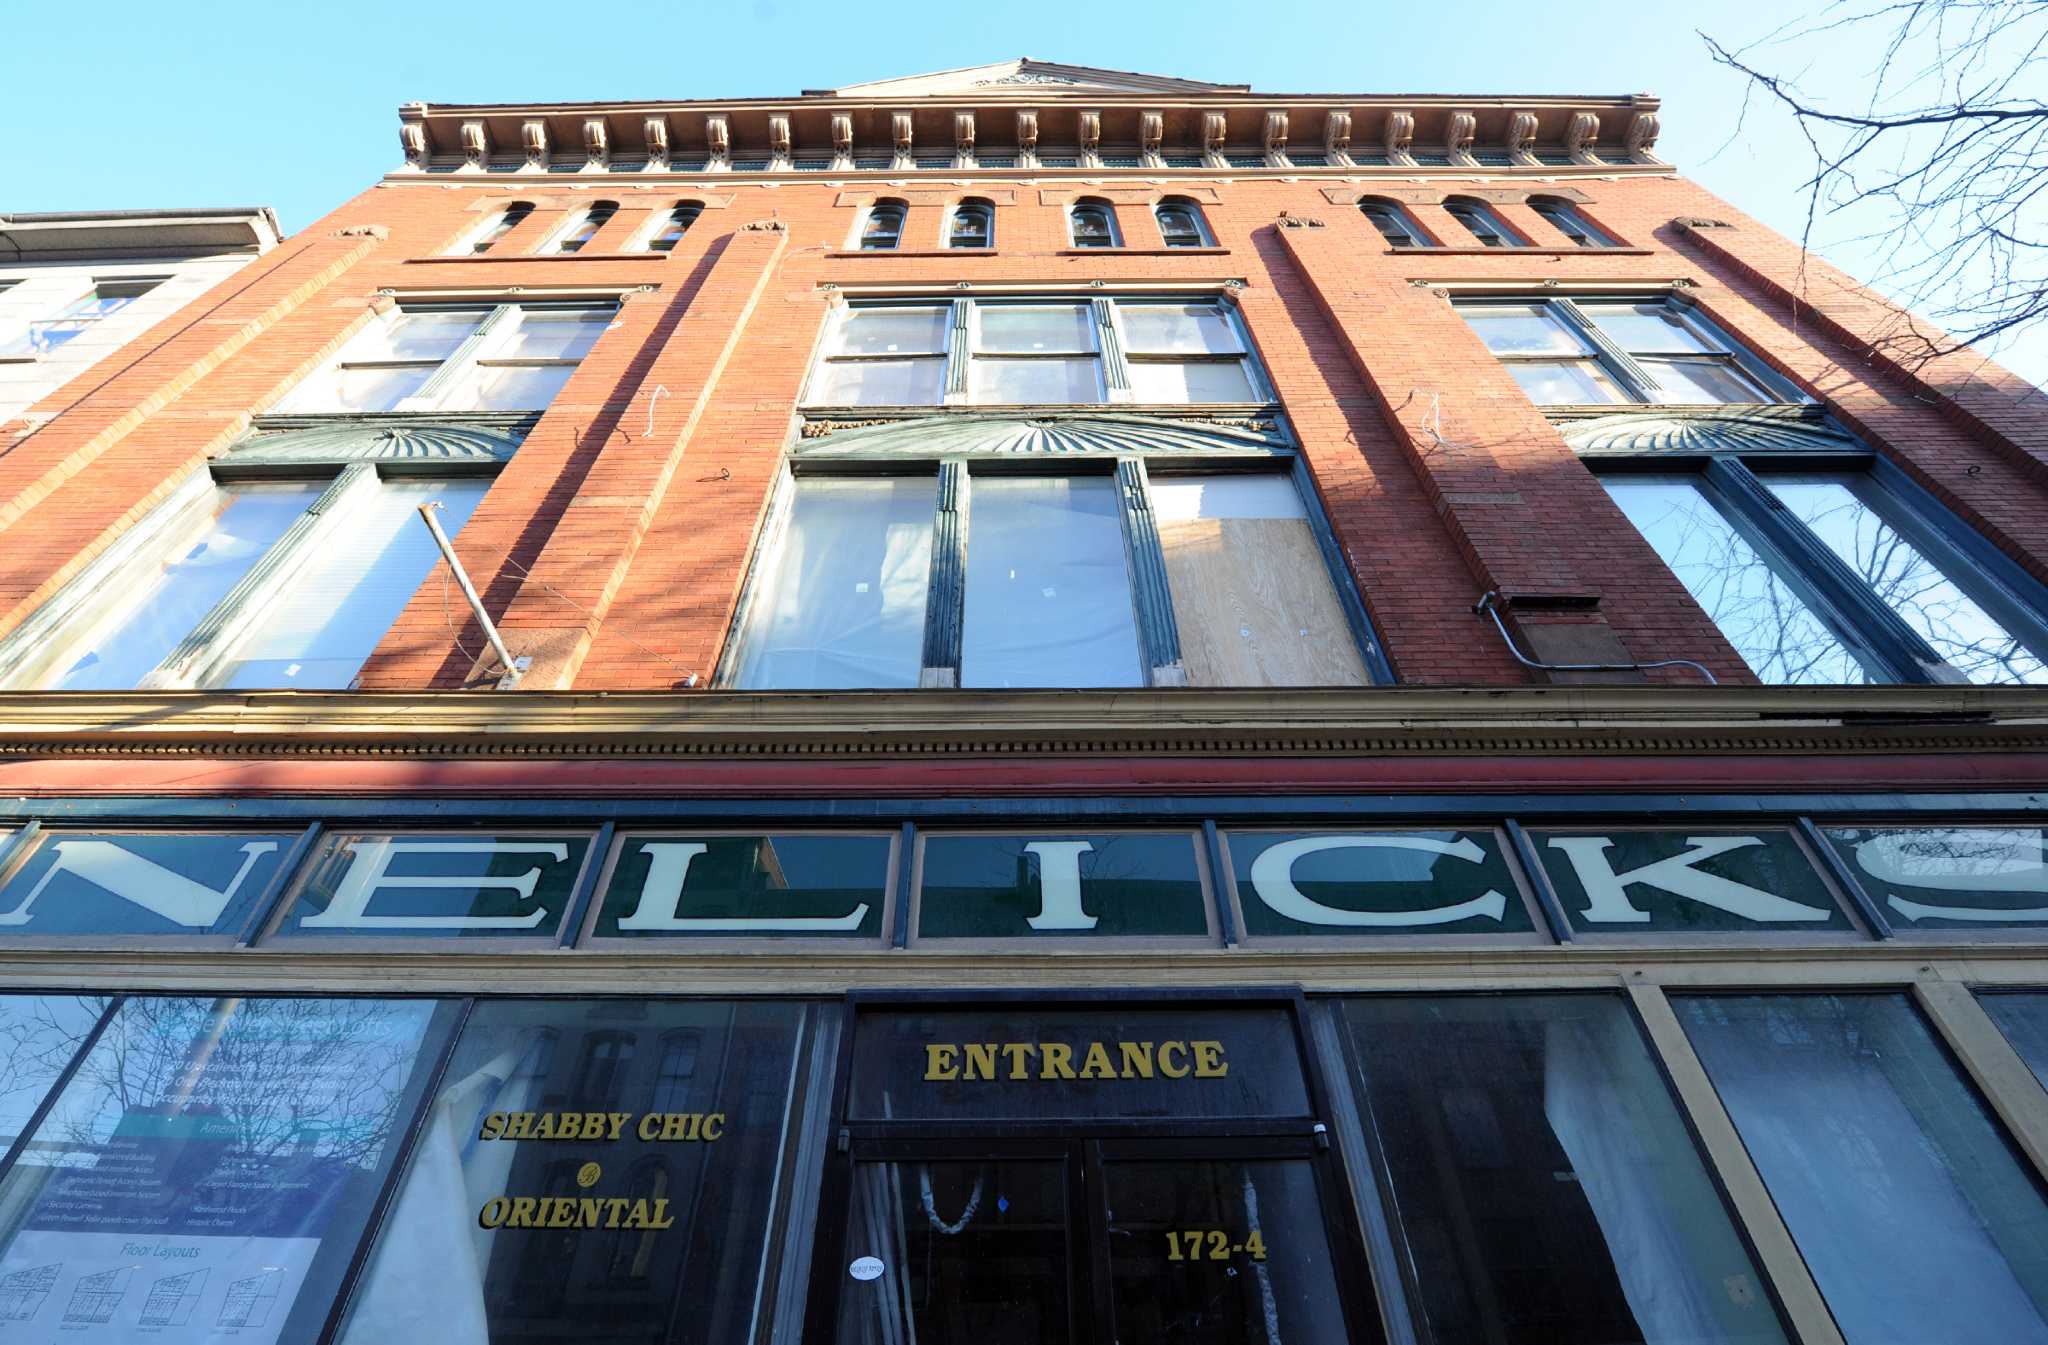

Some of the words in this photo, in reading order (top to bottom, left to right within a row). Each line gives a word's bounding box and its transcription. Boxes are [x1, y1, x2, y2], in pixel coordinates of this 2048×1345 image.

[924, 1040, 1228, 1081] ENTRANCE
[481, 1112, 631, 1141] SHABBY
[638, 1113, 726, 1141] CHIC
[480, 1197, 675, 1229] ORIENTAL
[120, 1241, 151, 1257] Floor
[153, 1240, 200, 1261] Layouts
[1165, 1230, 1267, 1261] 172-4
